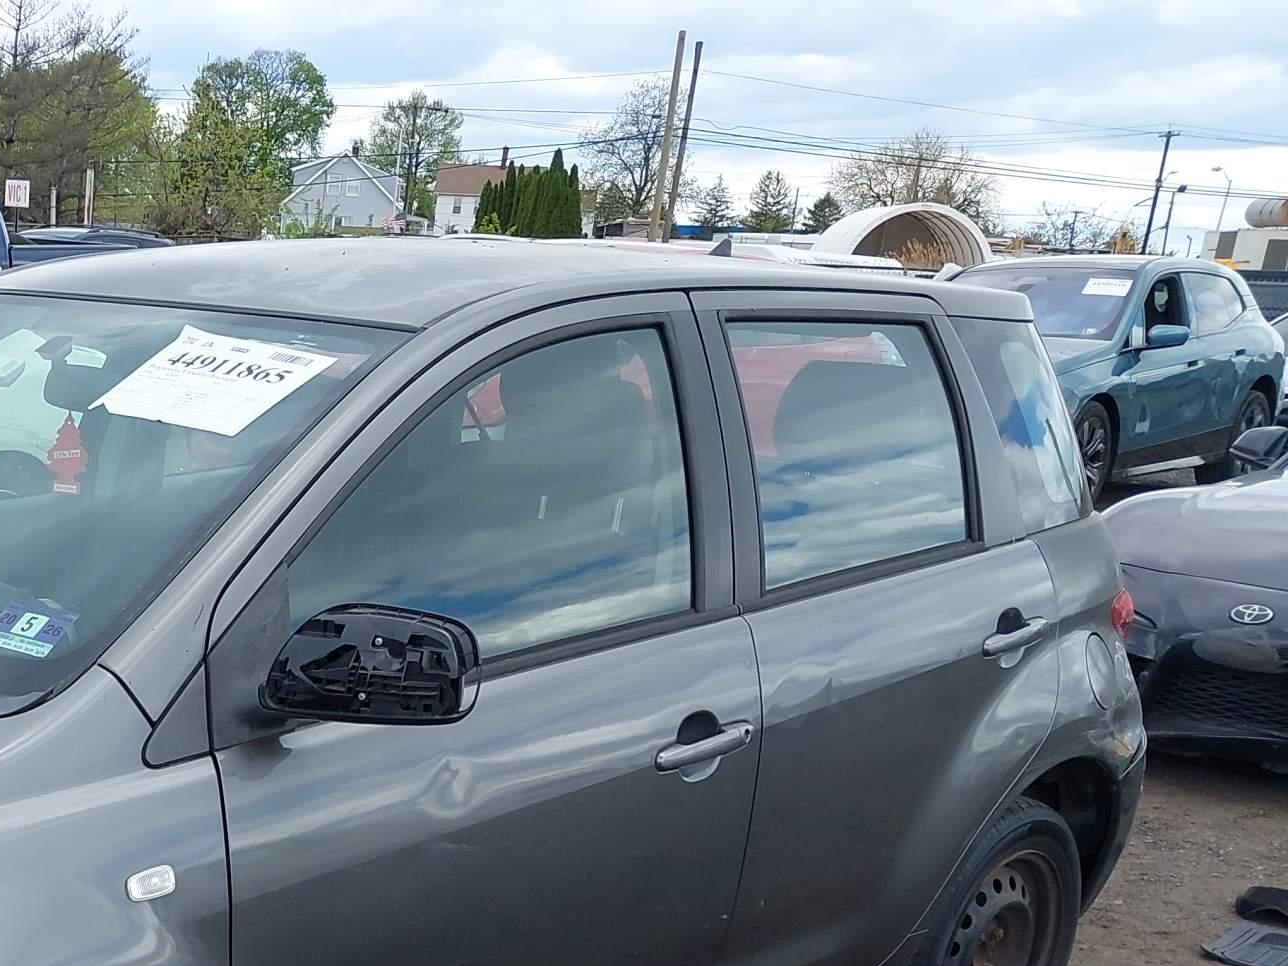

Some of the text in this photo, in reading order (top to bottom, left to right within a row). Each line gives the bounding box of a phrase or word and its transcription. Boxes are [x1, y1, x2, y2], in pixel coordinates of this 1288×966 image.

[8, 184, 22, 201] VIC
[168, 352, 294, 384] 44911865
[20, 616, 39, 633] 5
[43, 624, 64, 637] 26
